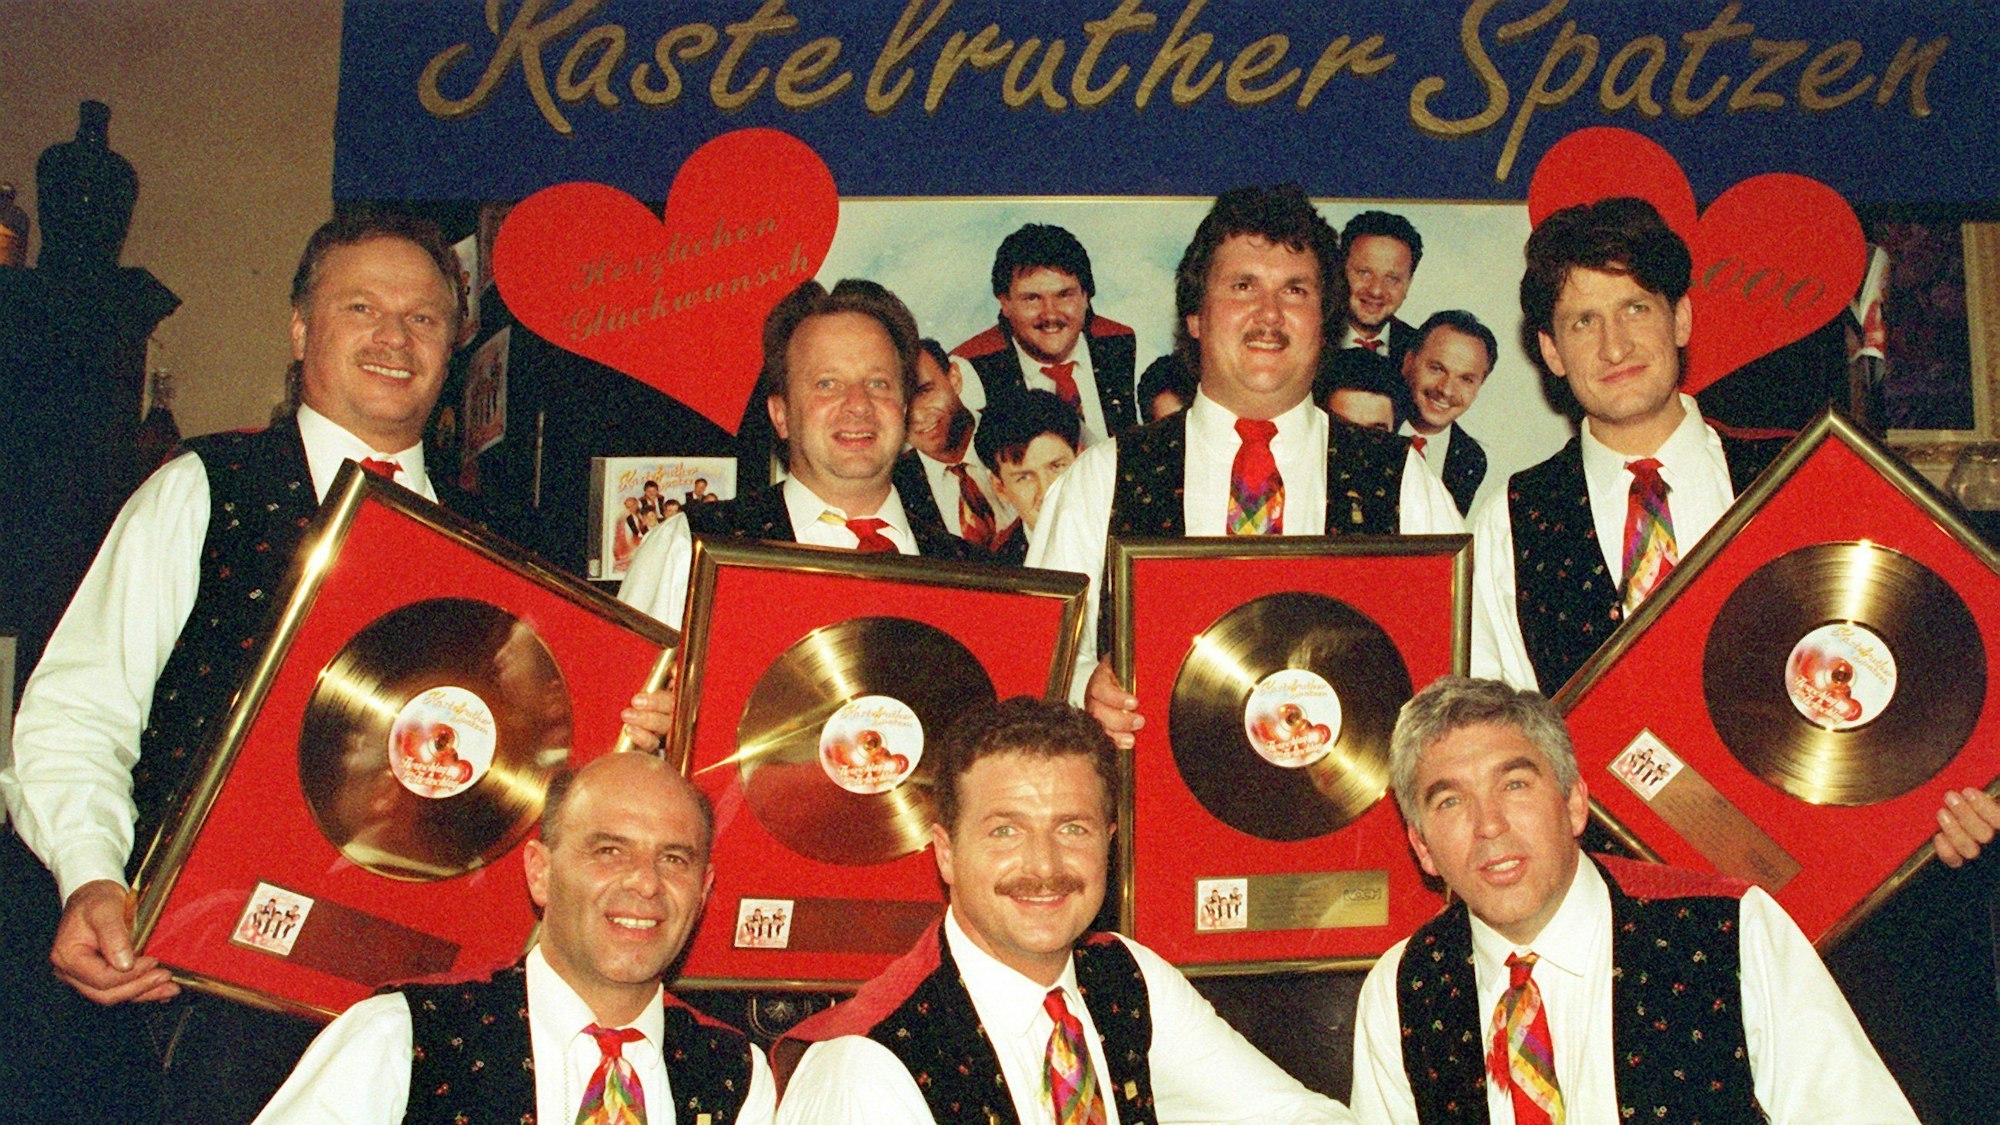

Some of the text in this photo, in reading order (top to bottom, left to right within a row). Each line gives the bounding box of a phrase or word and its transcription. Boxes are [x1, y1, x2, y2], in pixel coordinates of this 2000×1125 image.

[417, 0, 1950, 181] Kastelruther Spatzen
[563, 243, 811, 342] Glückwunsch
[571, 217, 777, 293] Herzlichen
